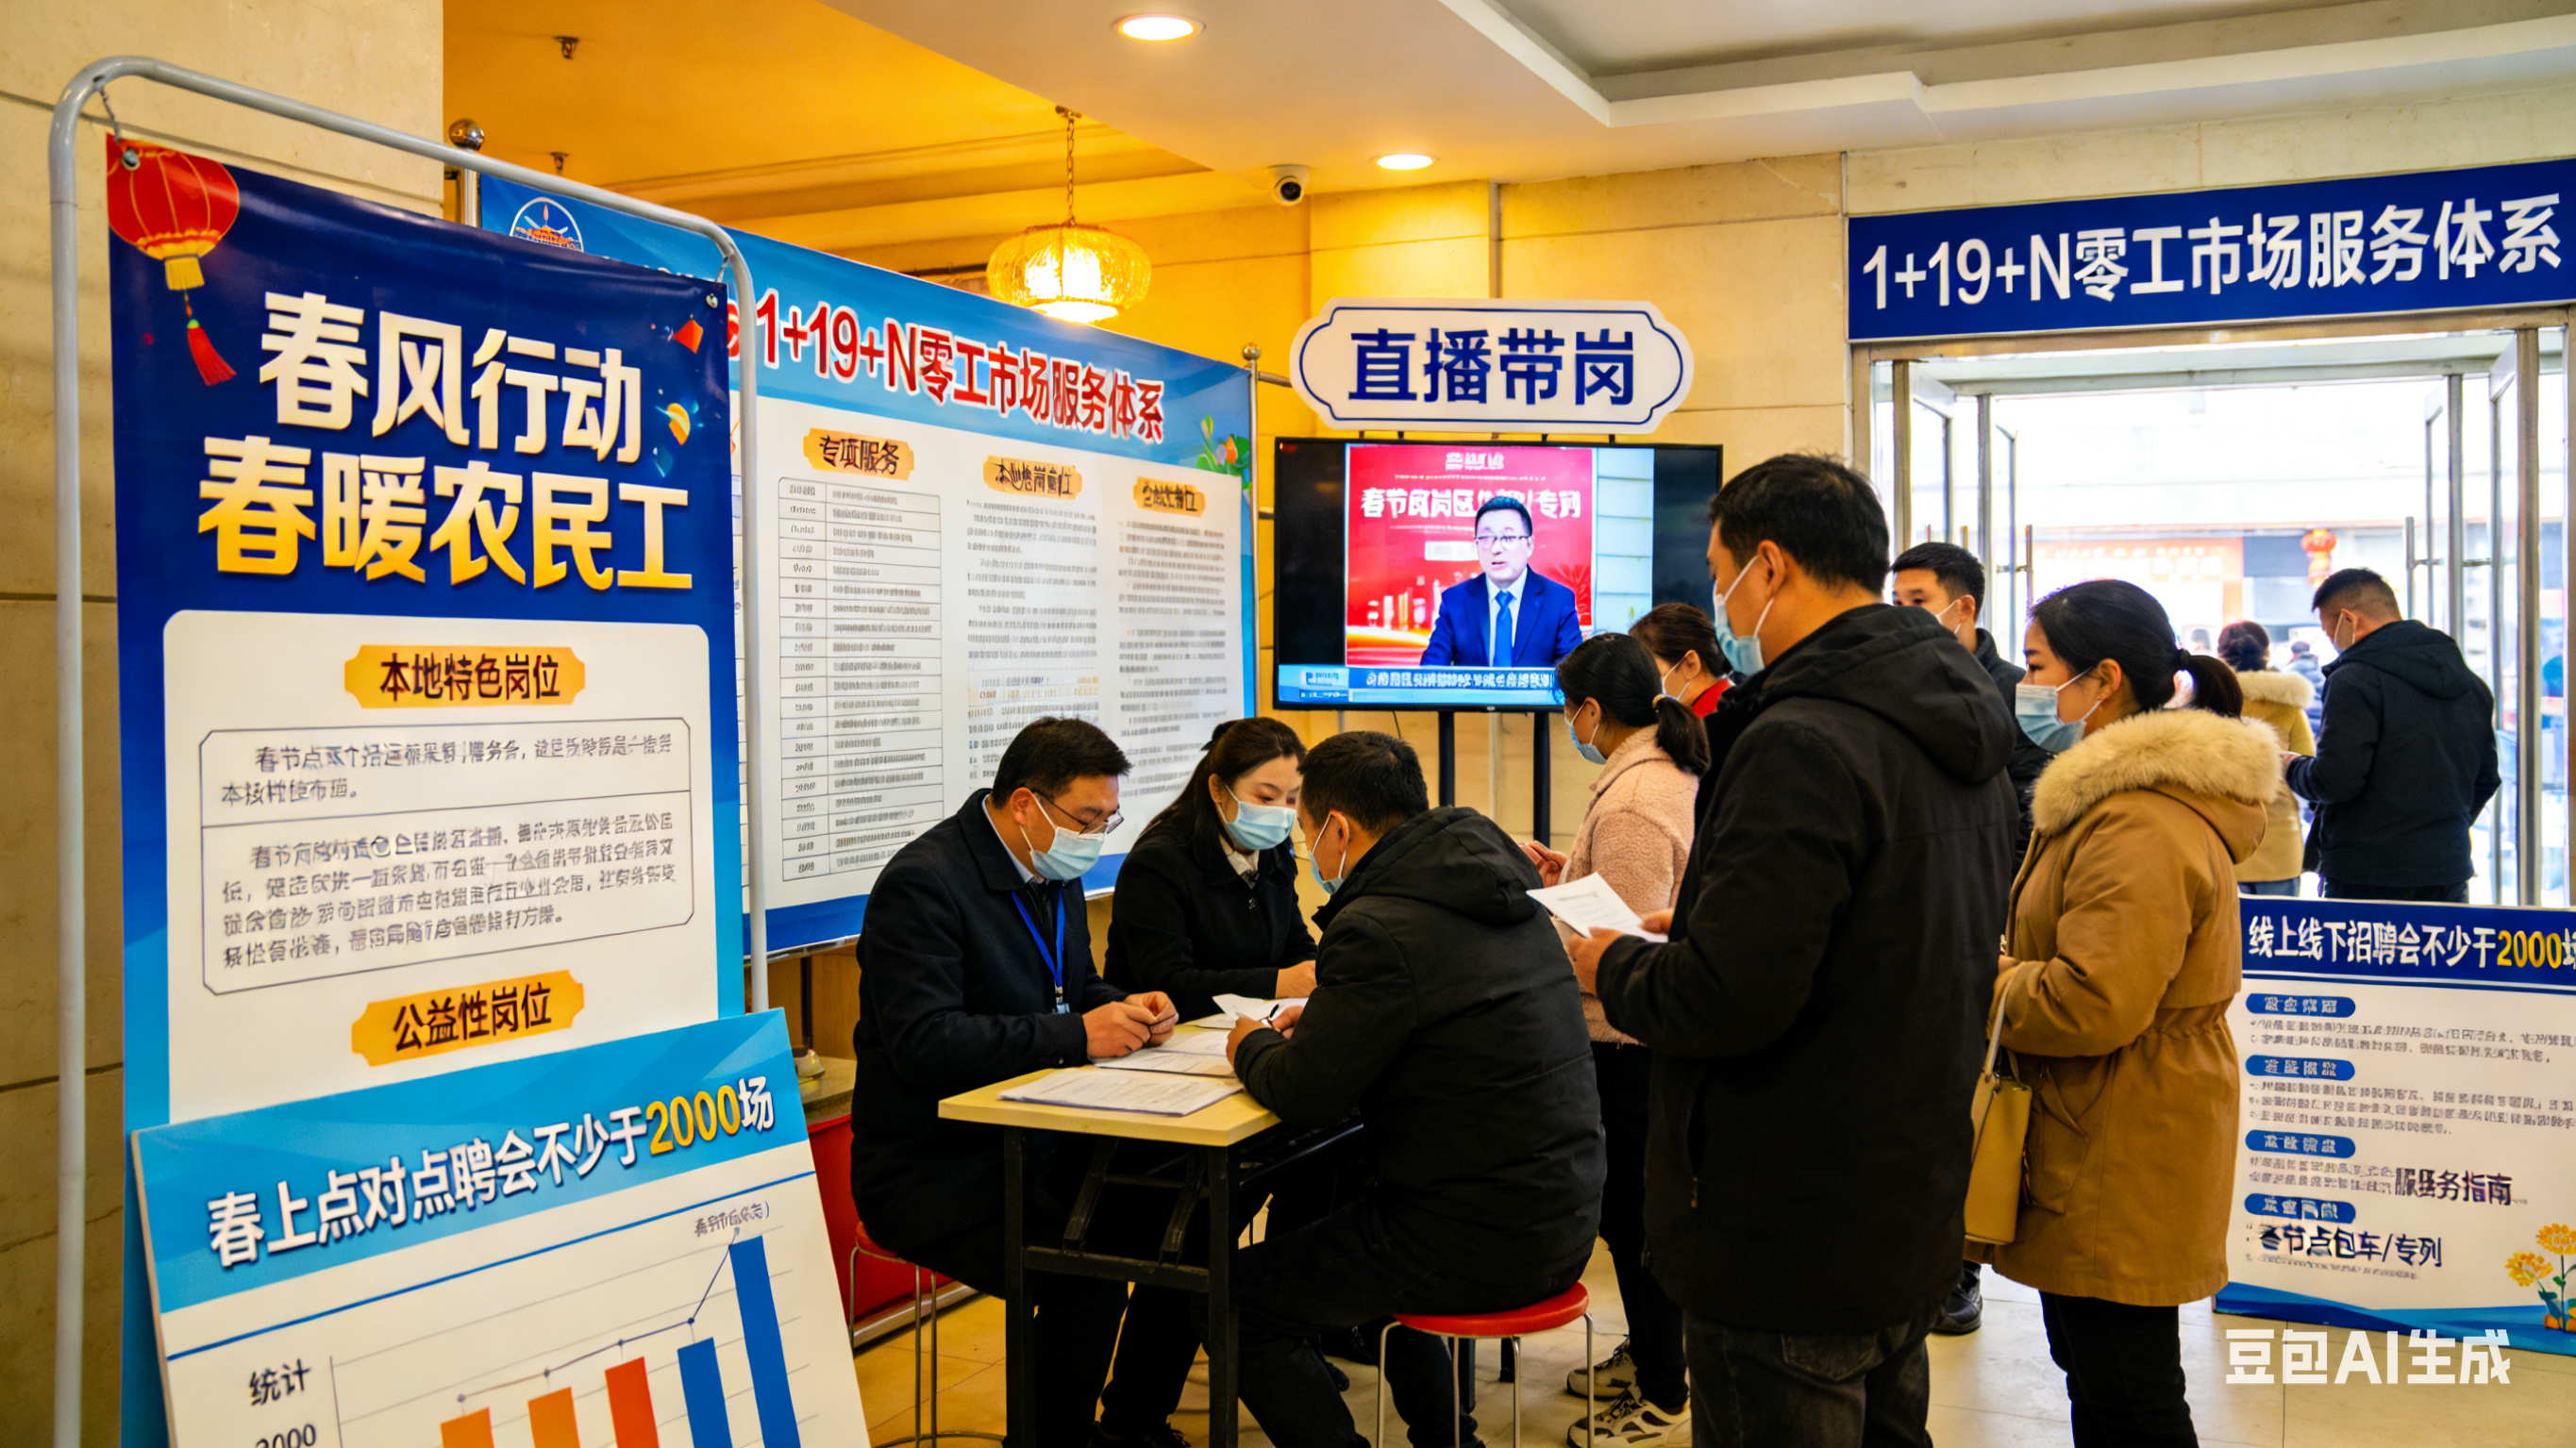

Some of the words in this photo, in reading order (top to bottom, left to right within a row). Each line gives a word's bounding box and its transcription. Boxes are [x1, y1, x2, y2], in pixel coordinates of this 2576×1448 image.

[1863, 193, 2562, 309] 1+19+N零工市场服务体系
[259, 291, 642, 464] 春风行动
[756, 287, 1164, 444] 1+19+N零工市场服务体系
[1348, 328, 1634, 406] 直播带岗
[198, 435, 693, 591] 春暖农民工
[379, 653, 560, 701] 本地特色岗位
[392, 982, 552, 1052] 公益性岗位
[208, 1075, 775, 1270] 春上点对点聘会不少于2000场
[249, 1358, 311, 1406] 统计
